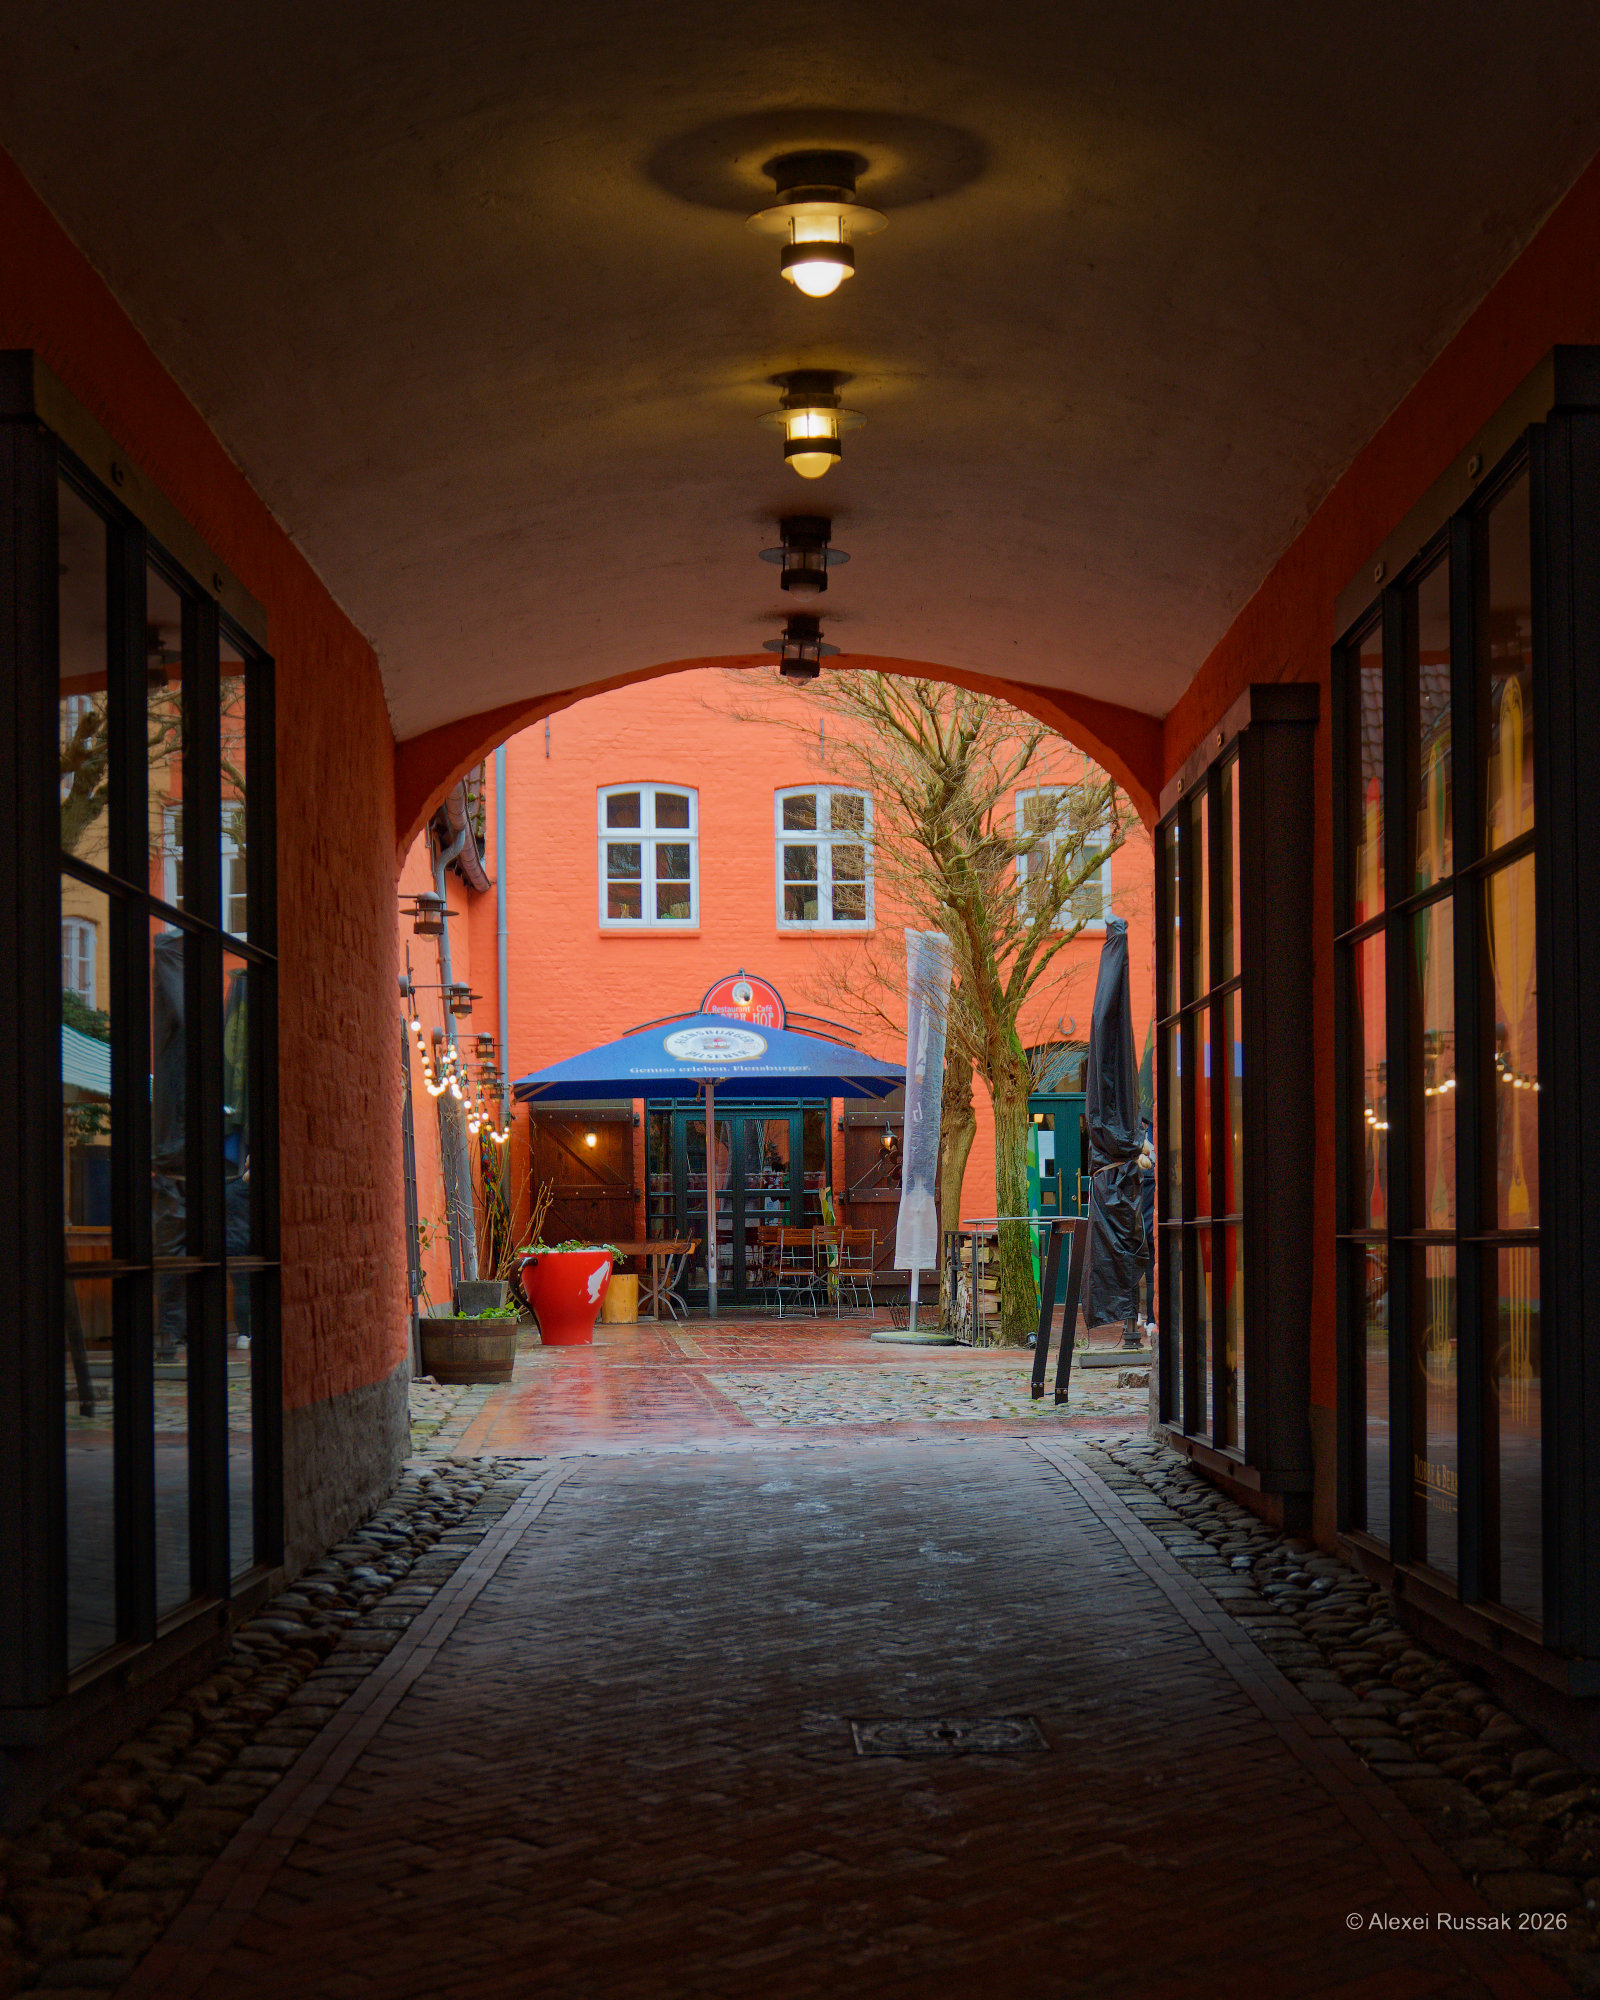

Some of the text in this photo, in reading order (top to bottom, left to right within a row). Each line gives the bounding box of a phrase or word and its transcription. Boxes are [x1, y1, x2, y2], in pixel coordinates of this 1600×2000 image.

[712, 1004, 773, 1013] Restaurant Café
[686, 1050, 750, 1059] PILSENER
